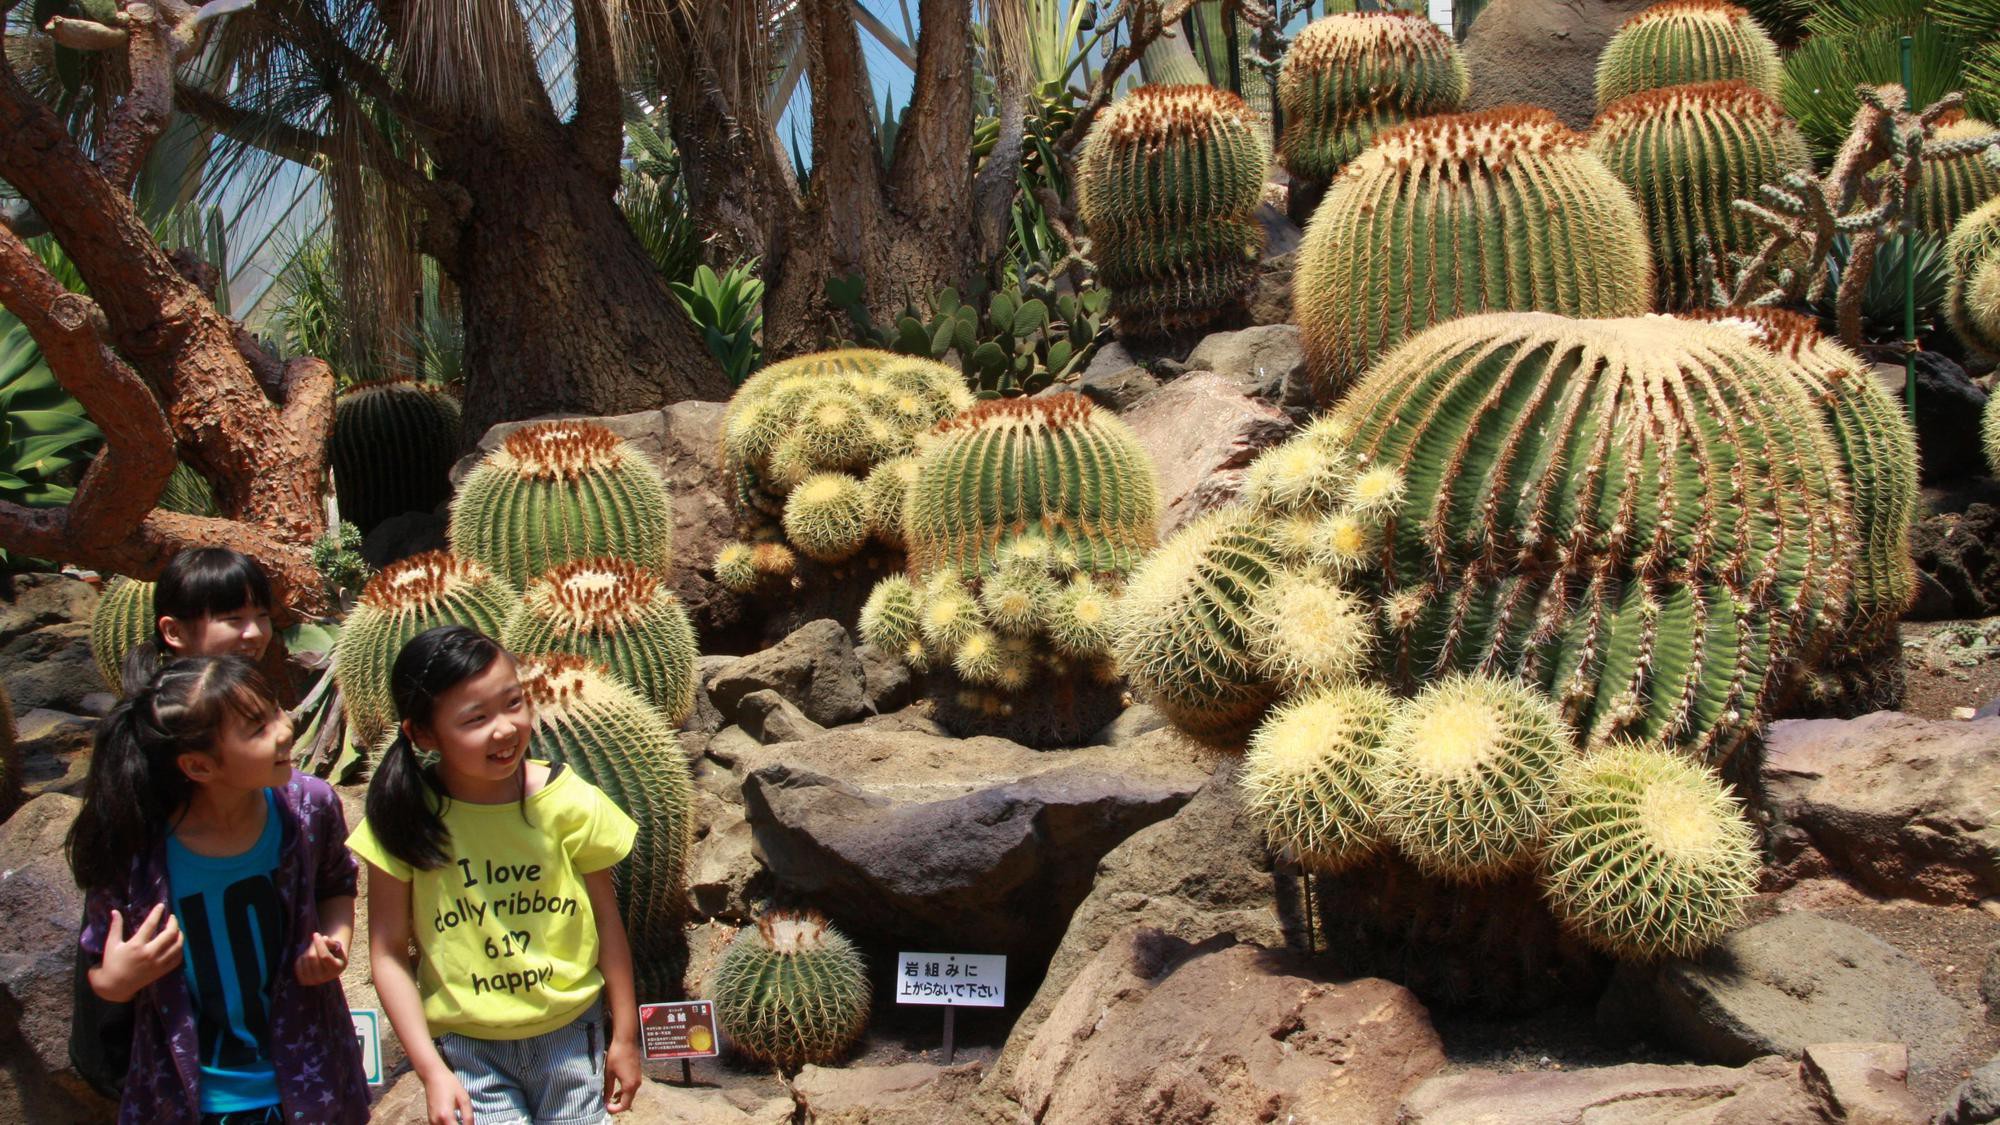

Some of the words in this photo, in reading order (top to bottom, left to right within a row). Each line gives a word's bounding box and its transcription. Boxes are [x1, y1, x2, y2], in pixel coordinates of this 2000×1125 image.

[457, 858, 478, 888] I
[486, 859, 541, 885] love
[434, 897, 487, 933] dolly
[493, 889, 577, 917] ribbon
[905, 961, 978, 977] 岩組みに
[901, 981, 999, 998] 上がらないで下さい
